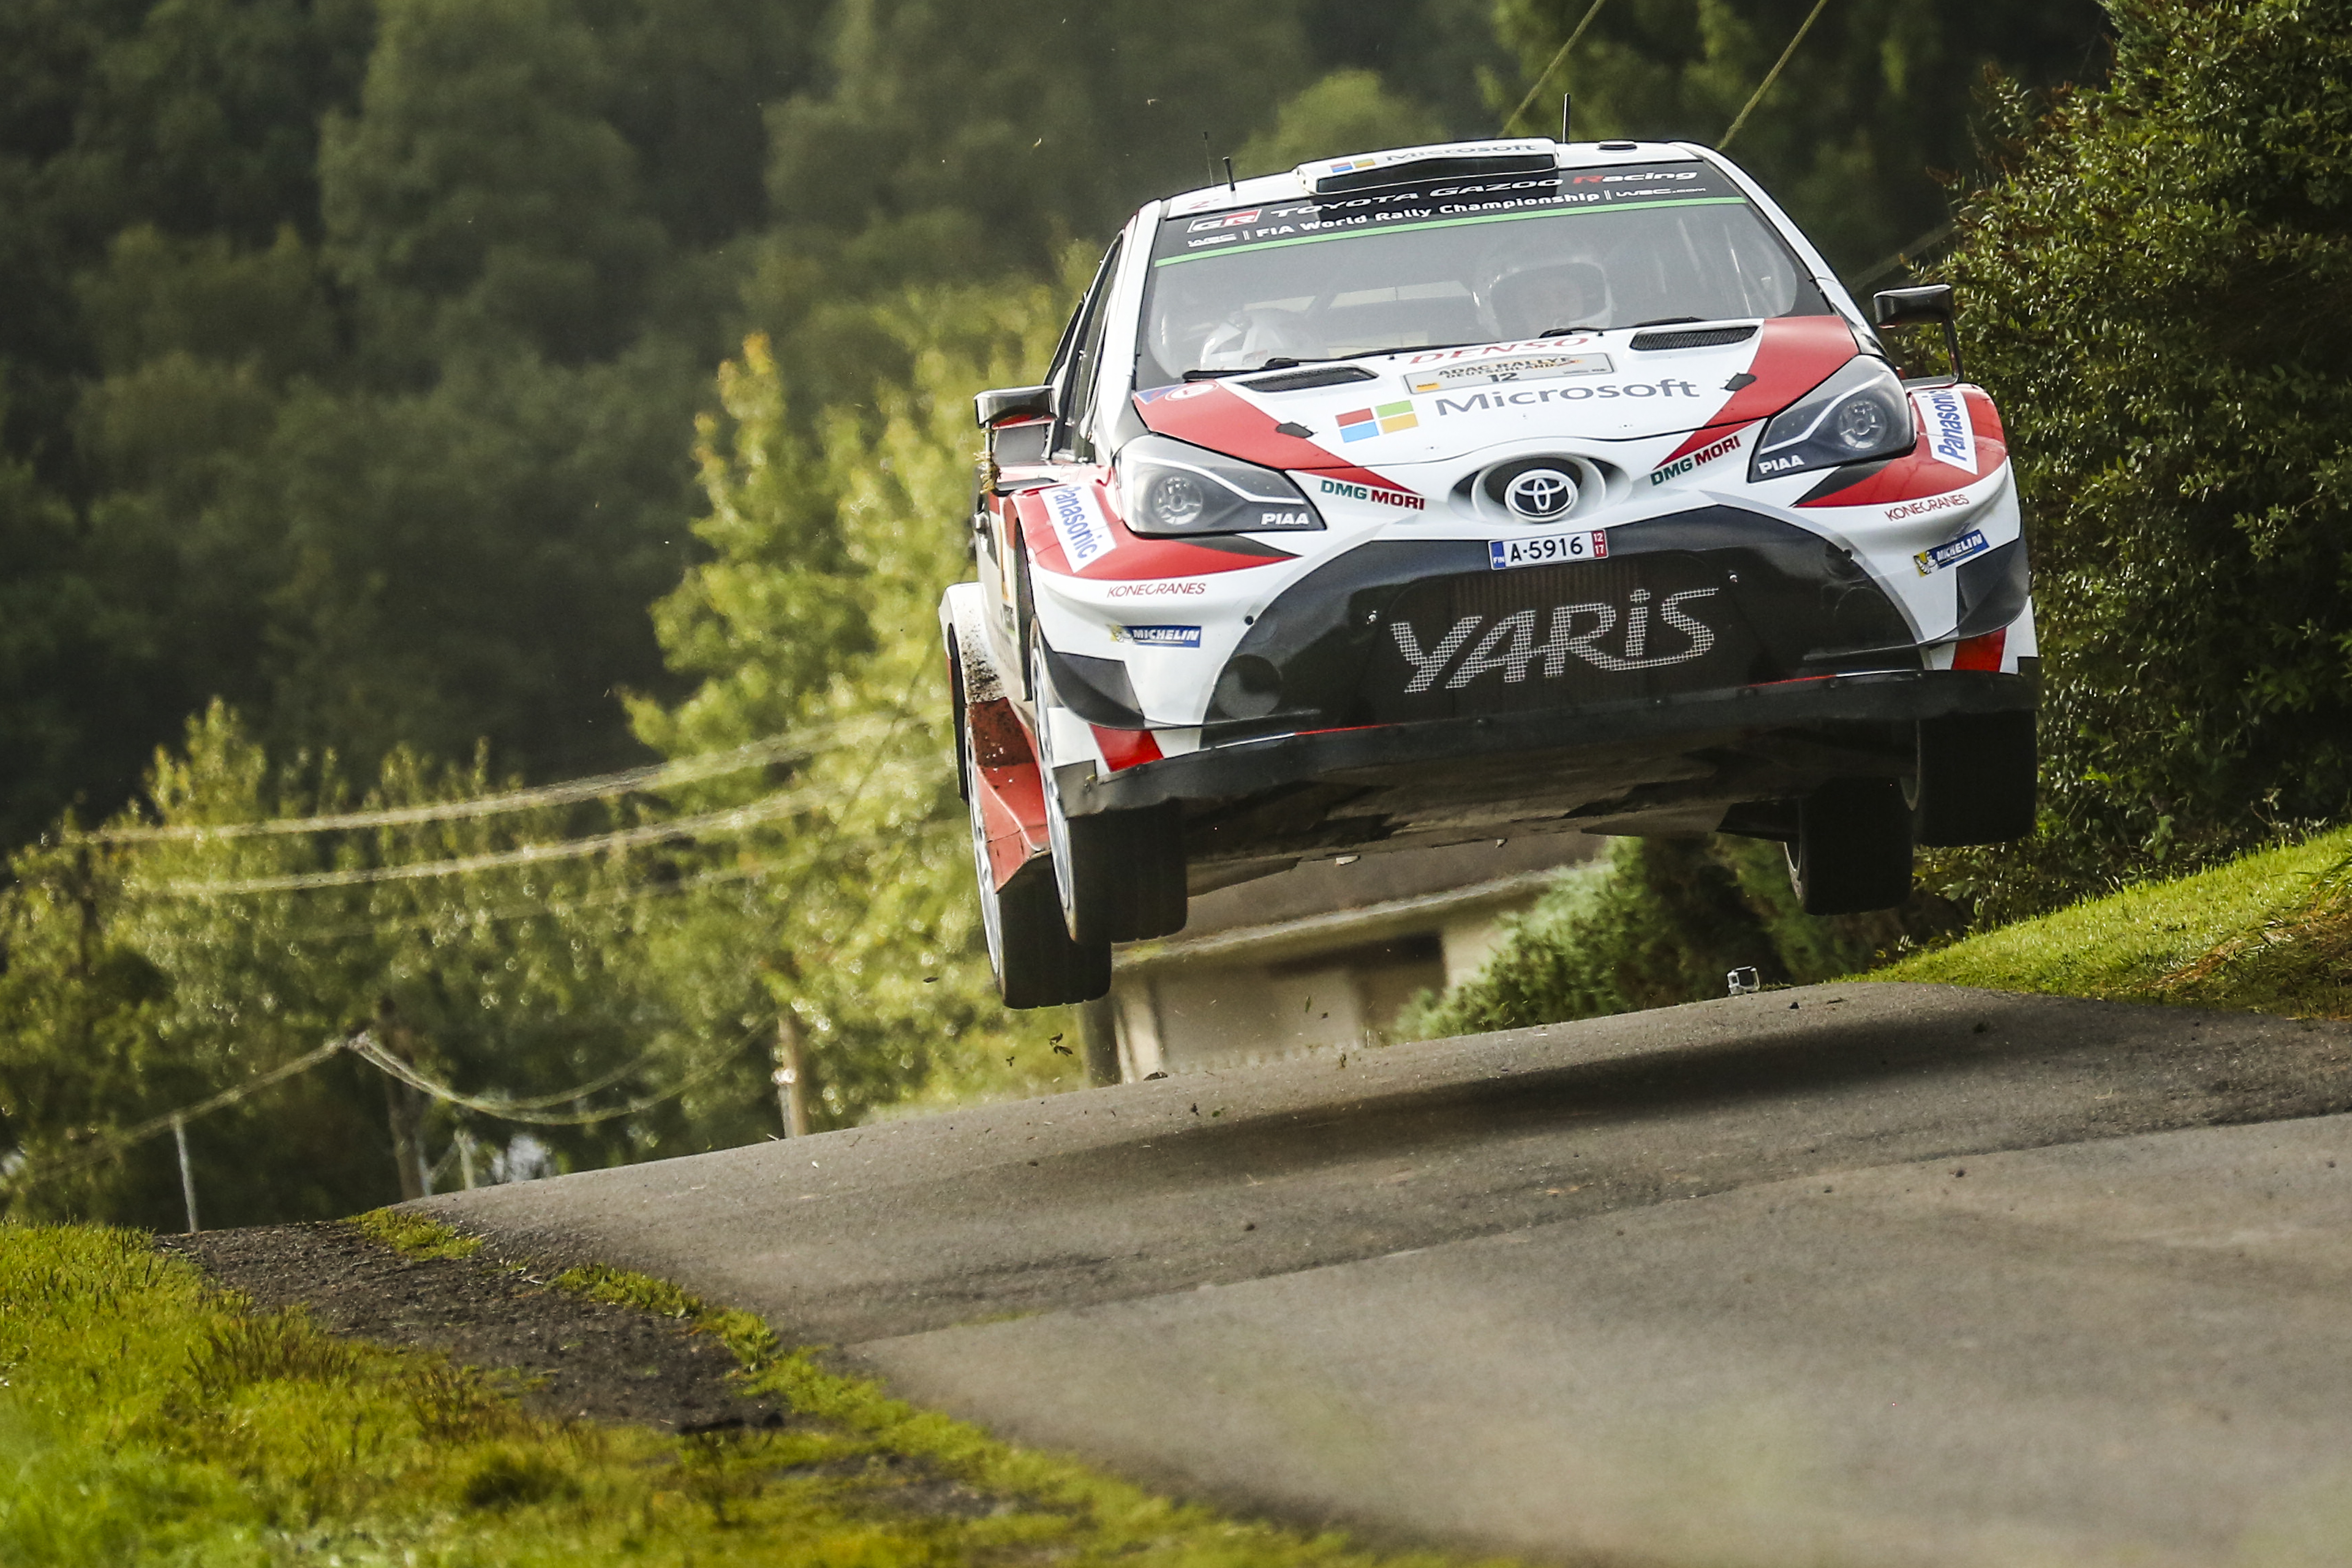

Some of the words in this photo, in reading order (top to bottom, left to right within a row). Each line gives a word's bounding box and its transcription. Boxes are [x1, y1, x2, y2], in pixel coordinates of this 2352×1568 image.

[1386, 144, 1536, 161] Microsoft
[1271, 192, 1419, 218] TOYOTA
[1430, 179, 1563, 197] GAZOO
[1573, 171, 1698, 184] Racing
[1191, 215, 1255, 231] GR
[1256, 225, 1295, 238] FIA
[1300, 215, 1367, 231] World
[1375, 207, 1431, 222] Rally
[1439, 192, 1600, 214] Championship
[1409, 338, 1589, 364] DENSO
[1438, 365, 1489, 376] ADAC
[1487, 372, 1520, 382] 12
[1435, 378, 1700, 416] Microsoft
[1922, 390, 1968, 462] Panasonic
[1650, 457, 1693, 486] DMG
[1694, 435, 1741, 466] MORI
[1758, 454, 1805, 474] PIAA
[1320, 479, 1367, 500] DMG
[1370, 489, 1425, 510] MORI
[1884, 493, 1970, 522] KONECRANES
[1050, 486, 1102, 559] Panasonic
[1261, 512, 1310, 525] PIAA
[1510, 536, 1583, 562] A-5916
[1593, 533, 1604, 542] 12
[1595, 544, 1605, 555] 17
[1936, 533, 1983, 562] MICHELIN
[1107, 582, 1207, 598] KONECRANES
[1132, 629, 1200, 641] MICHELIN
